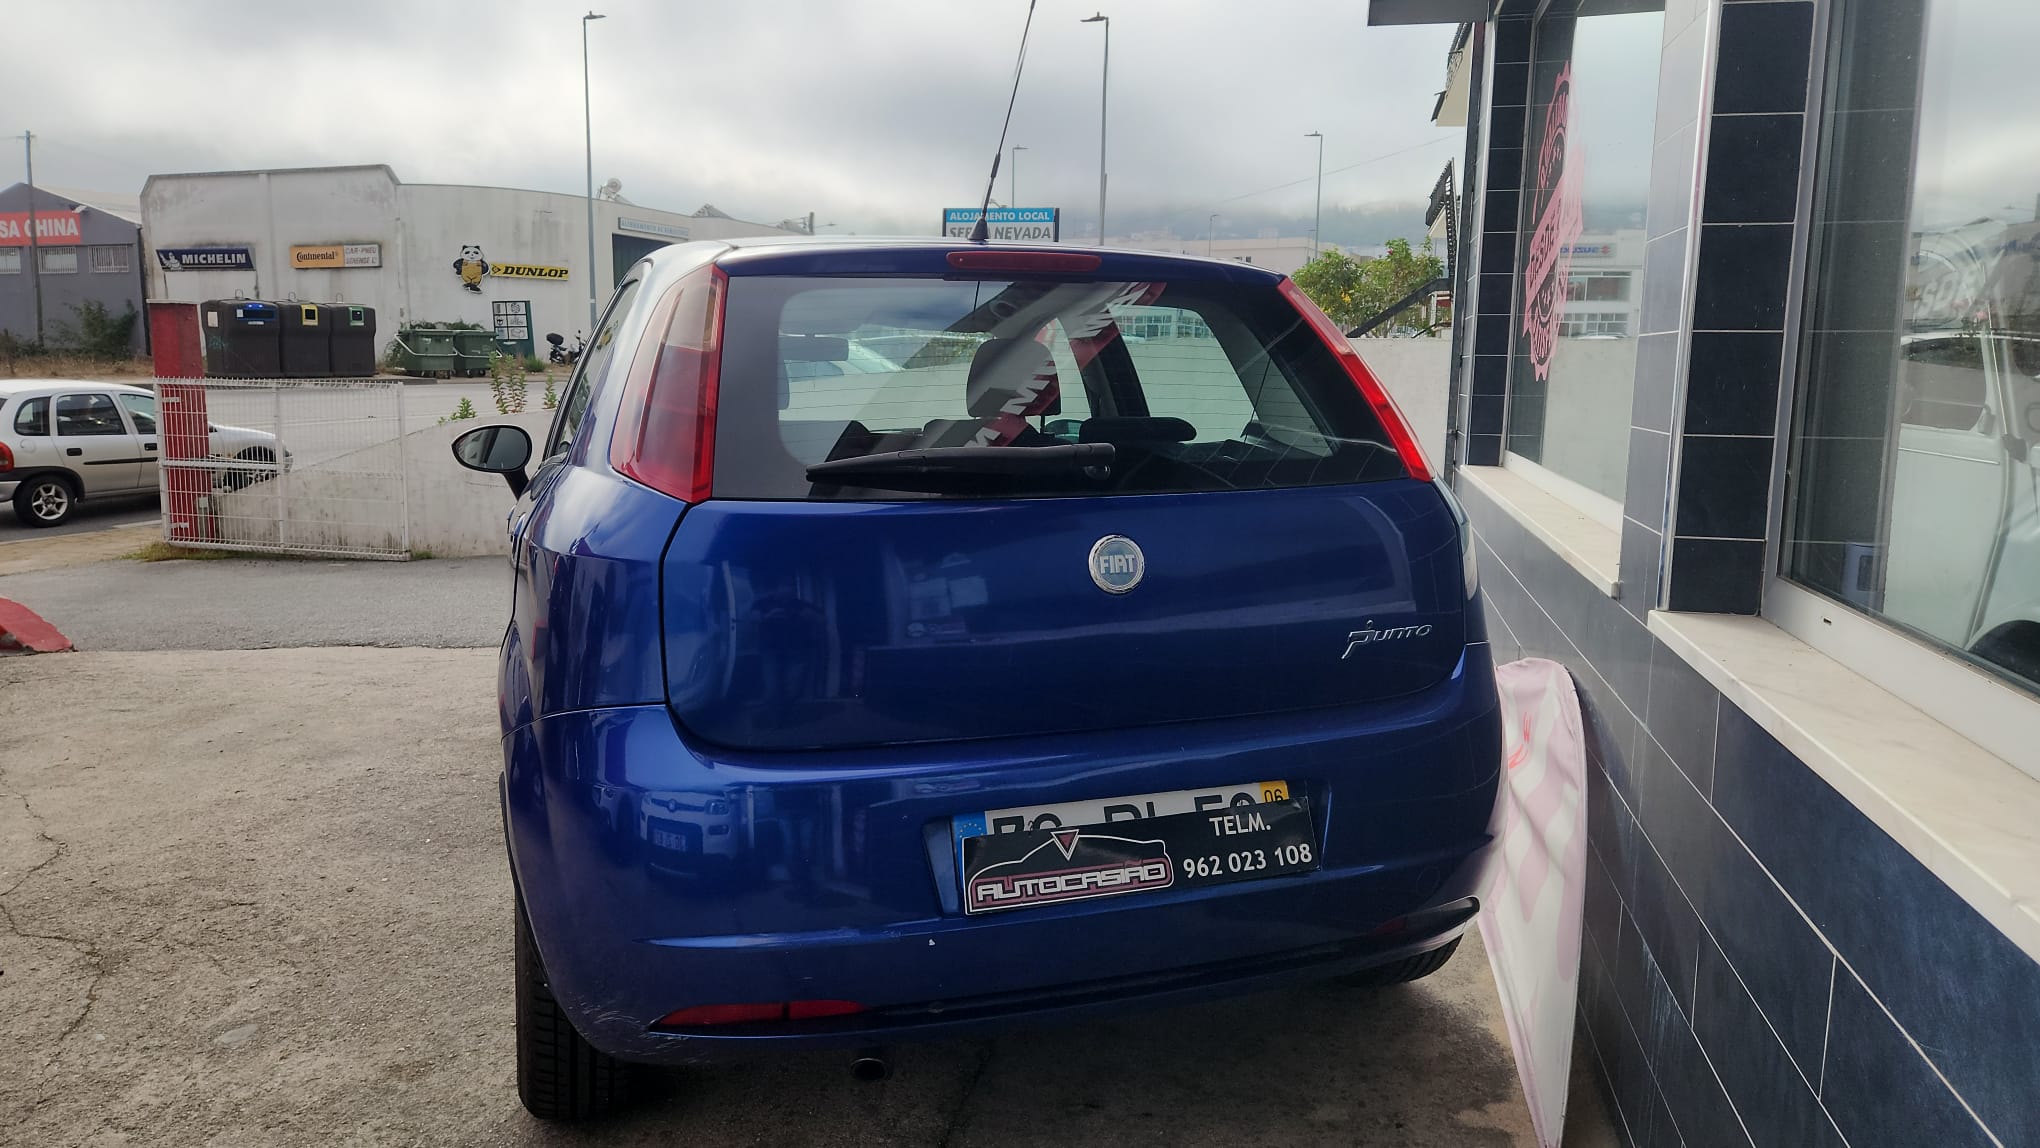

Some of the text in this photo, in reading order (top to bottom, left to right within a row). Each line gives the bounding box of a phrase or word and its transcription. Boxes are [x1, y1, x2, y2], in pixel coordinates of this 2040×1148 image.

[1018, 211, 1050, 221] LOCAL
[24, 217, 79, 237] CHINA
[994, 226, 1051, 240] NEVADA
[181, 253, 247, 264] MICHELIN
[296, 251, 336, 263] Continental
[503, 265, 569, 278] DUNLOP
[1100, 554, 1135, 574] FIAT
[1209, 812, 1272, 836] TELM.
[1183, 843, 1313, 879] 962 023 108
